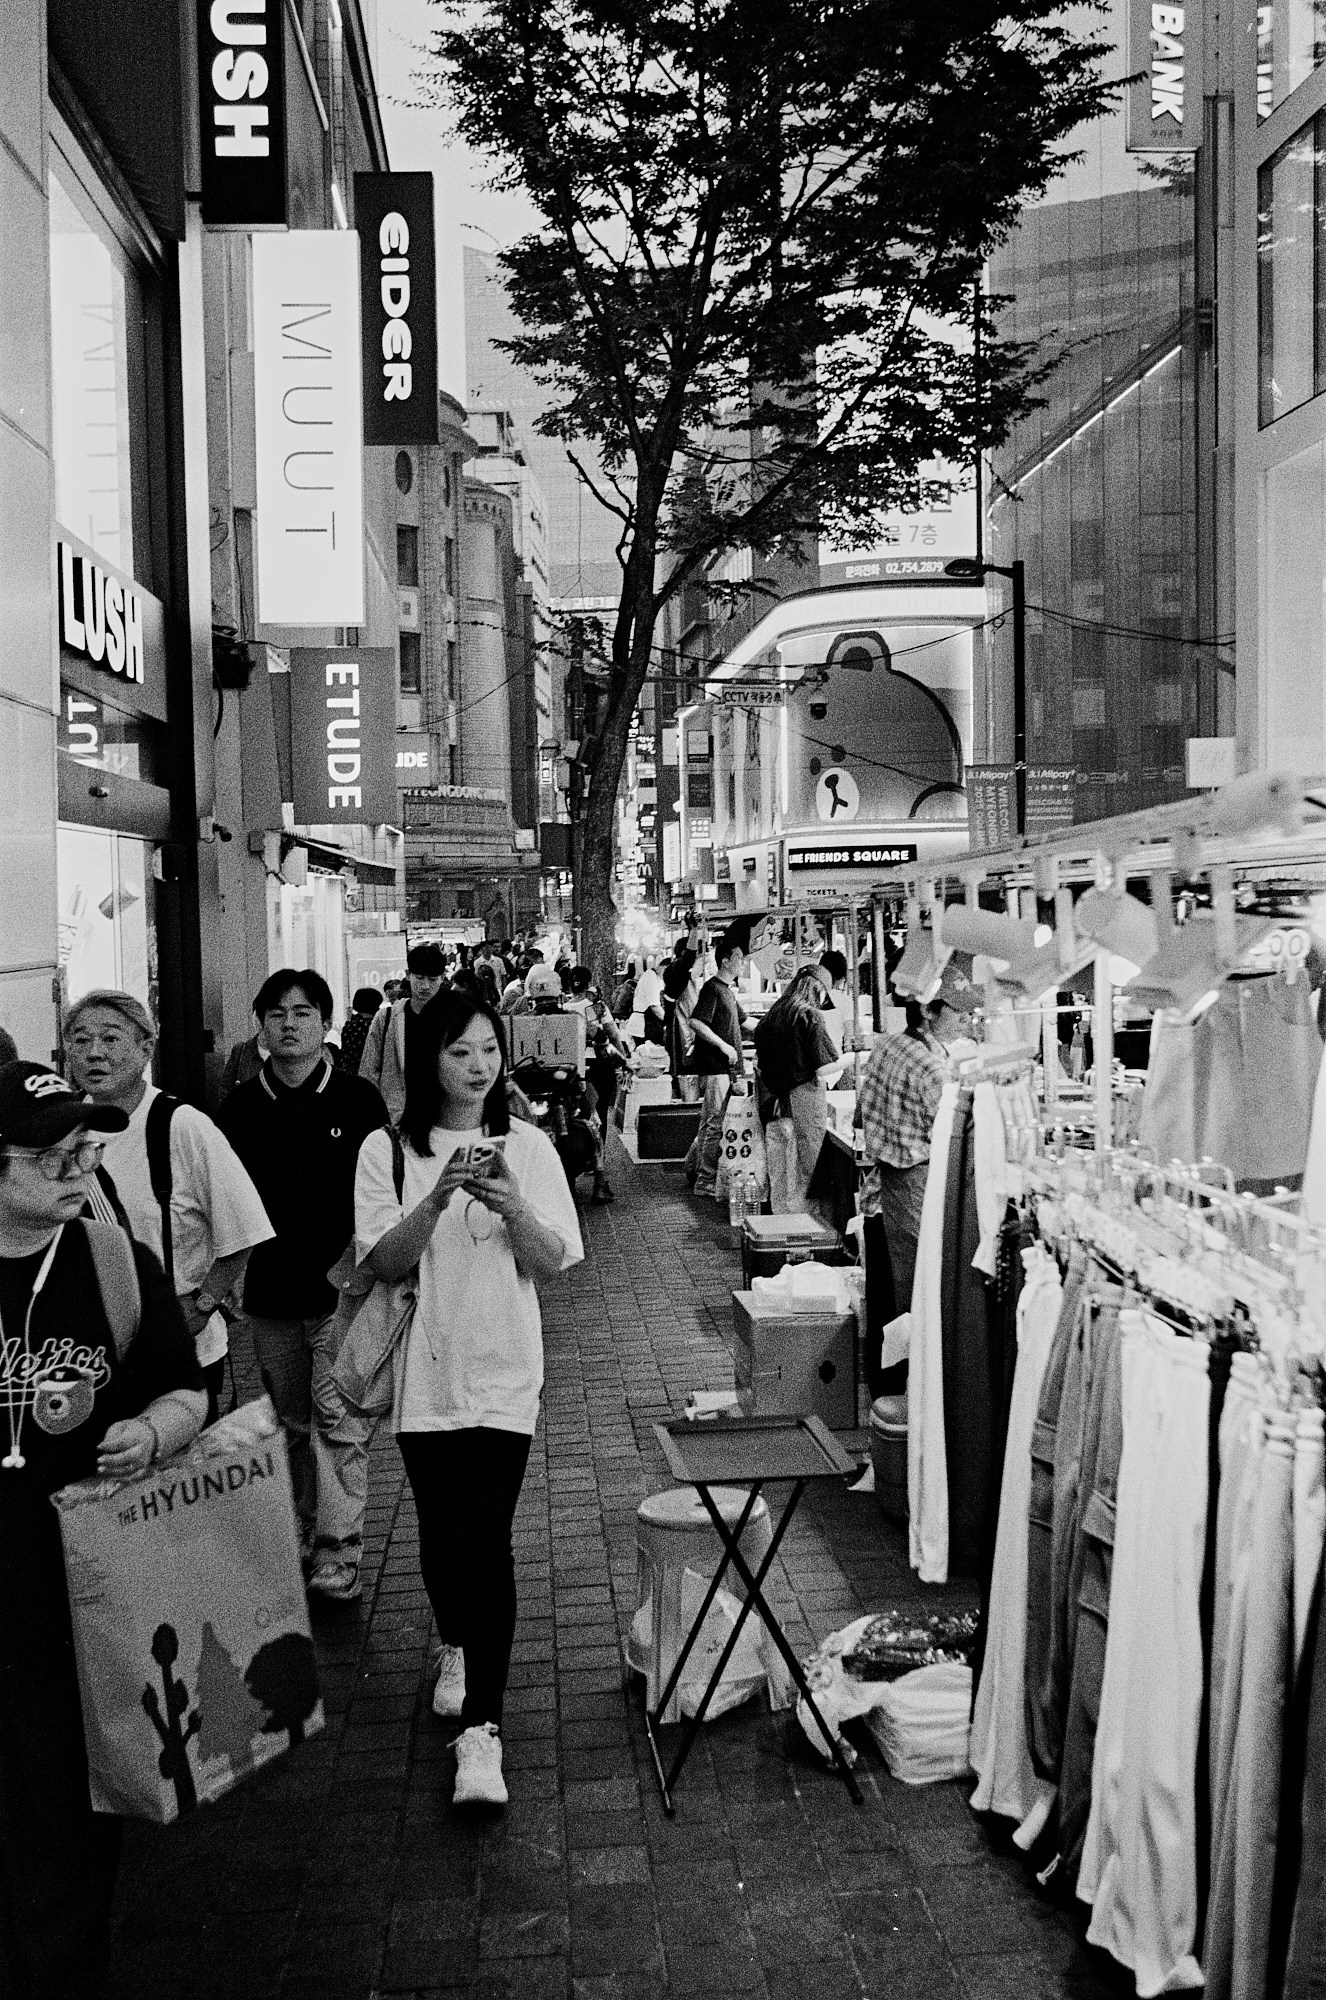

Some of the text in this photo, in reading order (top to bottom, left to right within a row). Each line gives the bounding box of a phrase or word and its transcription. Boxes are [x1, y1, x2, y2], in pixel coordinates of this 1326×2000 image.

[1150, 3, 1184, 125] BANK
[379, 212, 412, 401] EIDER
[281, 303, 336, 550] MUUT
[885, 561, 944, 573] 02.754.2879
[908, 524, 938, 546] 7층
[60, 541, 145, 684] LUSH
[325, 663, 362, 808] ETUDE
[724, 691, 749, 702] CCTV
[805, 851, 849, 863] FRIENDS
[853, 850, 909, 862] SQUARE
[117, 1453, 275, 1527] THE HYUNDAI
